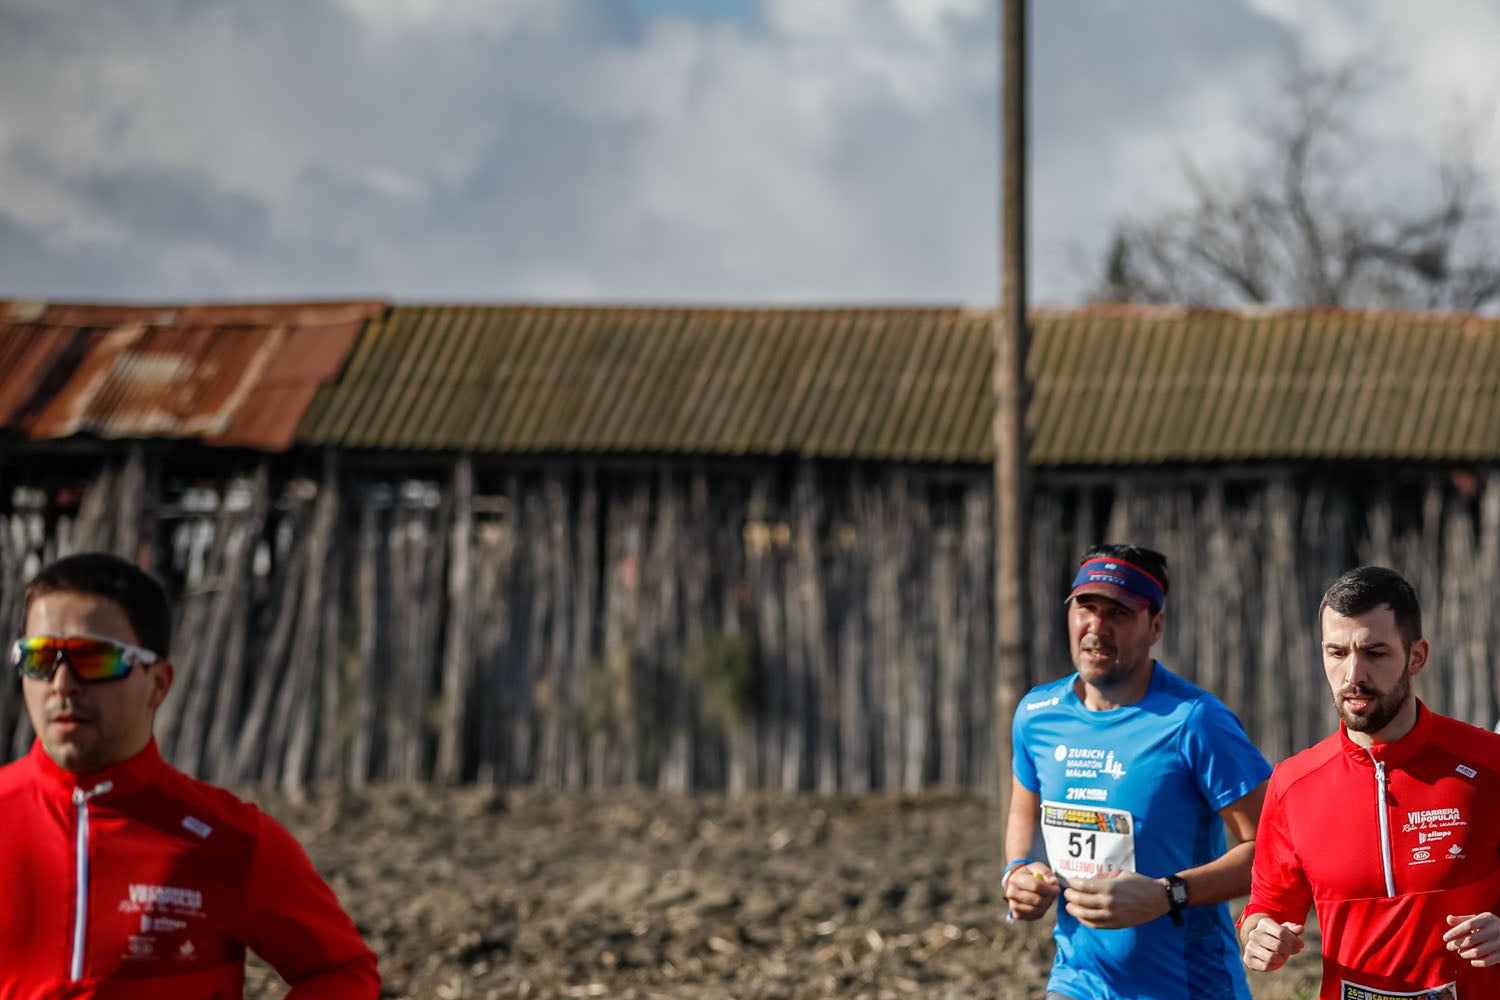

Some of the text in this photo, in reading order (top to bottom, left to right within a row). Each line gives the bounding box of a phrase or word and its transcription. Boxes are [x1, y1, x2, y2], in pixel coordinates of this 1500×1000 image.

[1068, 748, 1105, 759] ZURICH
[1065, 768, 1097, 778] MÁLAGA
[1065, 787, 1088, 800] 21K
[1408, 808, 1460, 824] VII CARRERA
[1420, 813, 1460, 823] POPULAR
[1427, 830, 1452, 838] olimpo
[1068, 832, 1096, 860] 51
[1347, 987, 1358, 997] 26
